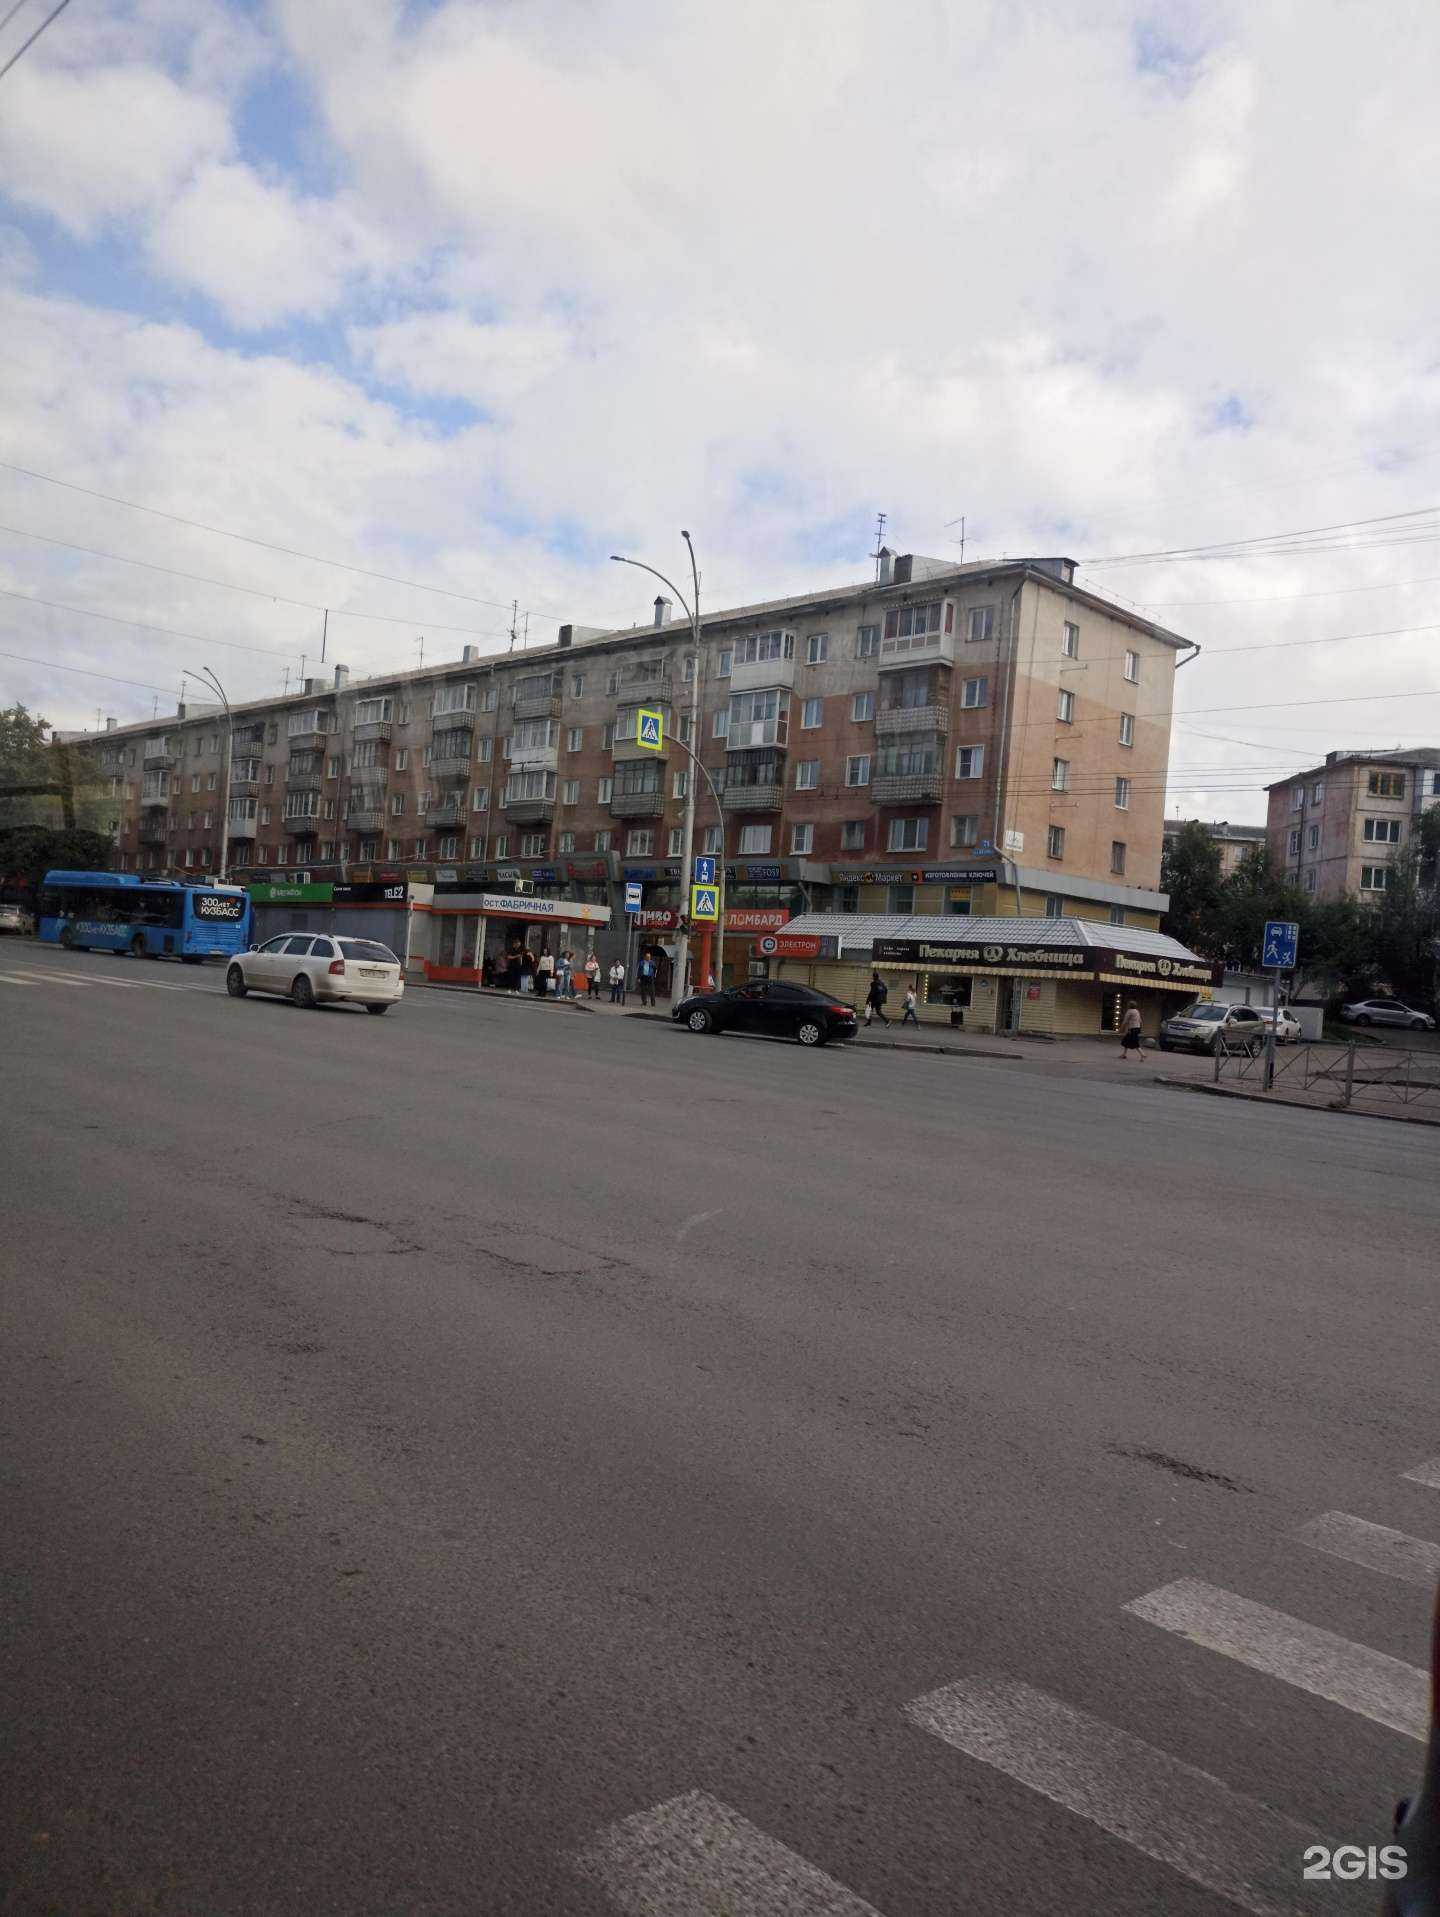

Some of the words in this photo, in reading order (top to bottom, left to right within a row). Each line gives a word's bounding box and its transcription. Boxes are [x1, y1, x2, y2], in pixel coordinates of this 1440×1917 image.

[875, 872, 904, 882] Маркет
[968, 869, 995, 880] КЛЮЧЕЙ
[200, 907, 239, 918] КУЗБАСС
[729, 914, 784, 926] ЛОМБАРД
[779, 940, 817, 950] ЭЛЕКТРОН
[919, 944, 980, 962] Пекарня
[1006, 948, 1084, 965] Хлебница
